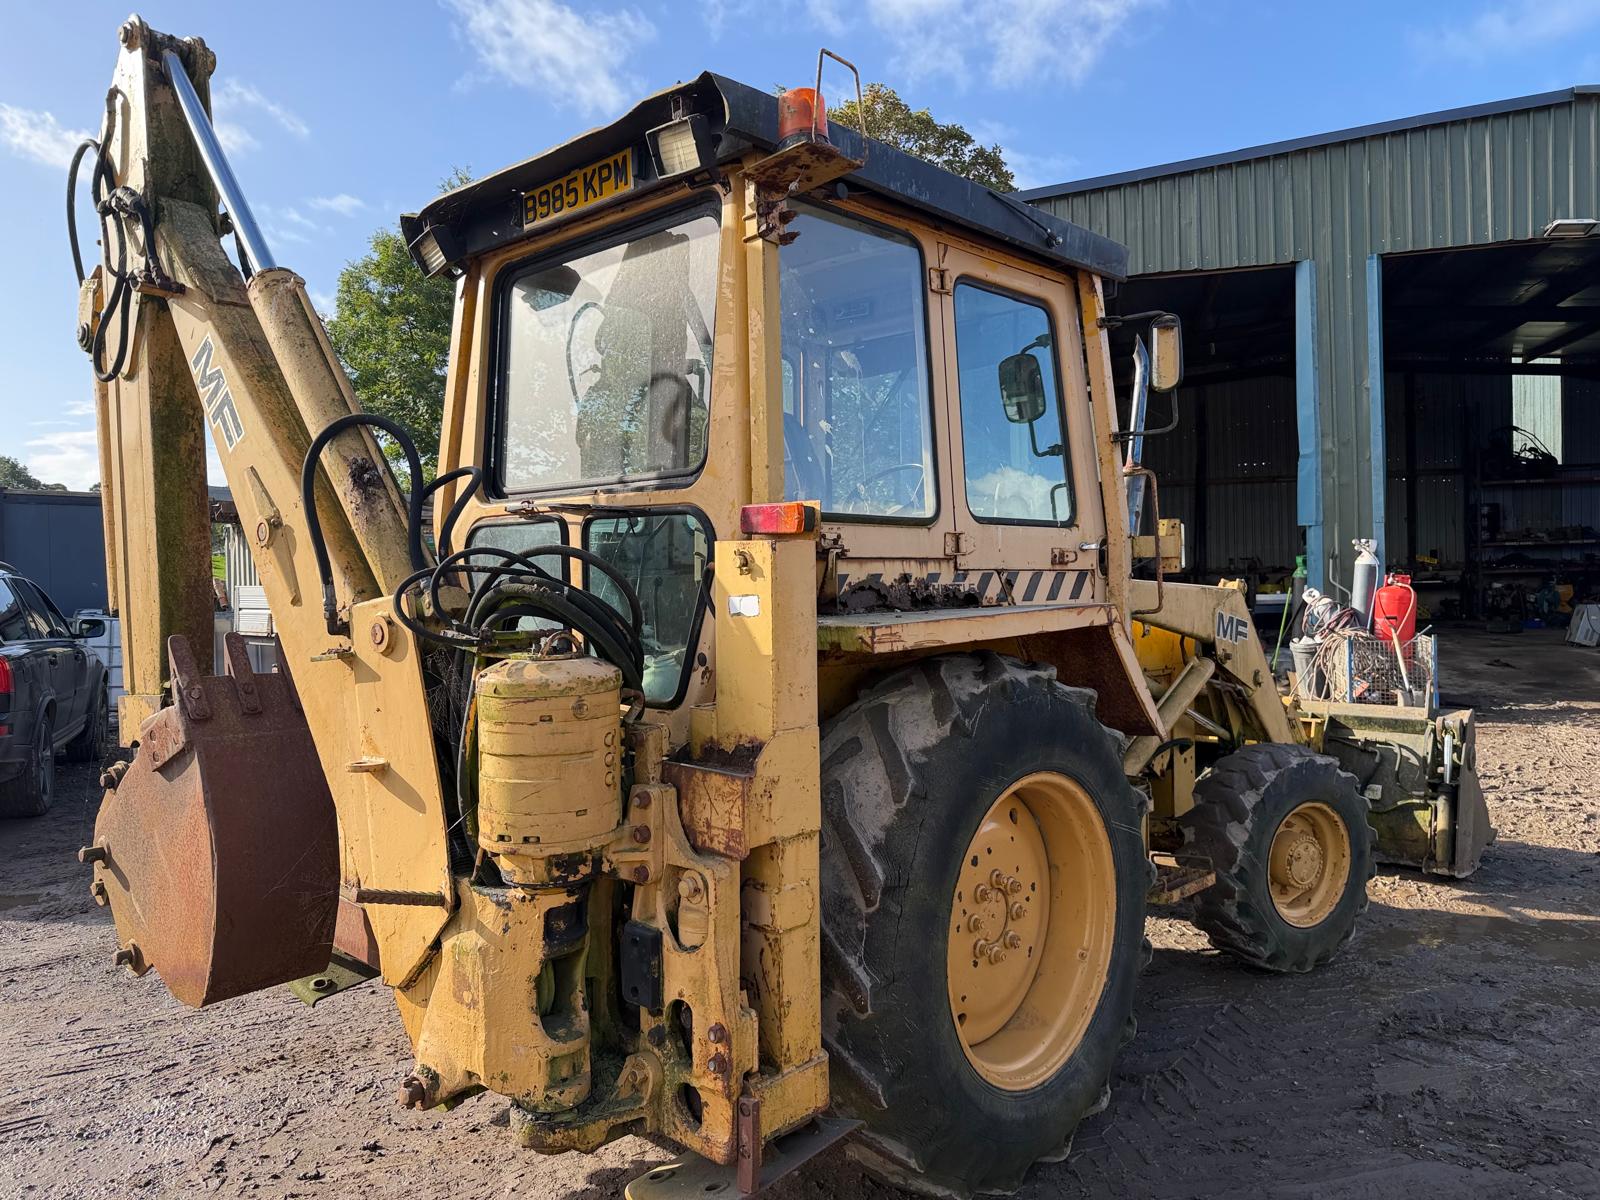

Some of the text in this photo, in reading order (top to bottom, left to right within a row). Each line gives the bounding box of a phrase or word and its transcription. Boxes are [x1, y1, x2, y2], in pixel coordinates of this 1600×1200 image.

[524, 154, 629, 225] B985 KPM
[191, 333, 244, 453] MF
[1216, 610, 1248, 645] MF
